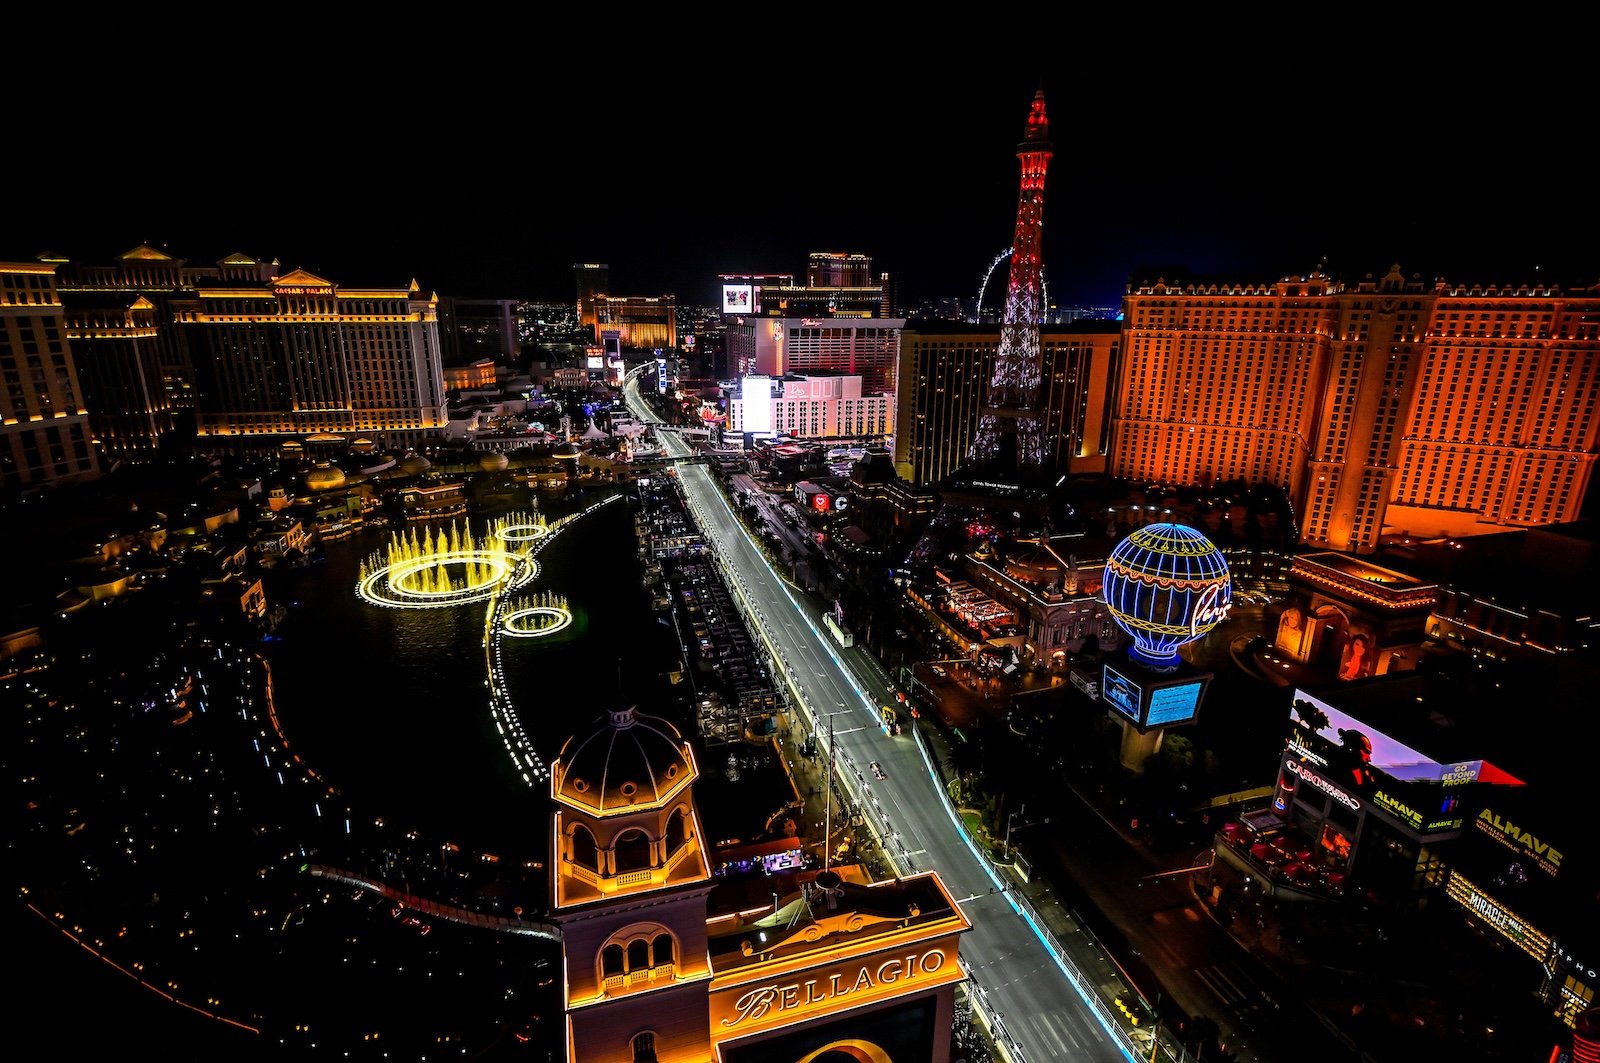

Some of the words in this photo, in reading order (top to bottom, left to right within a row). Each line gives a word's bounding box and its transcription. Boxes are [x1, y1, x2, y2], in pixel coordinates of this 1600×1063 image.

[1190, 583, 1233, 637] Paris
[1442, 769, 1476, 781] BEYOND
[1442, 778, 1471, 788] PROOF
[1454, 764, 1468, 773] GO
[1374, 790, 1424, 824] ALMAVE
[1427, 820, 1453, 829] ALMAVE
[1478, 808, 1564, 868] ALMAVE
[1470, 891, 1509, 930] MIRACLE
[1507, 918, 1524, 933] MILE
[720, 949, 946, 1027] BELLAGIO
